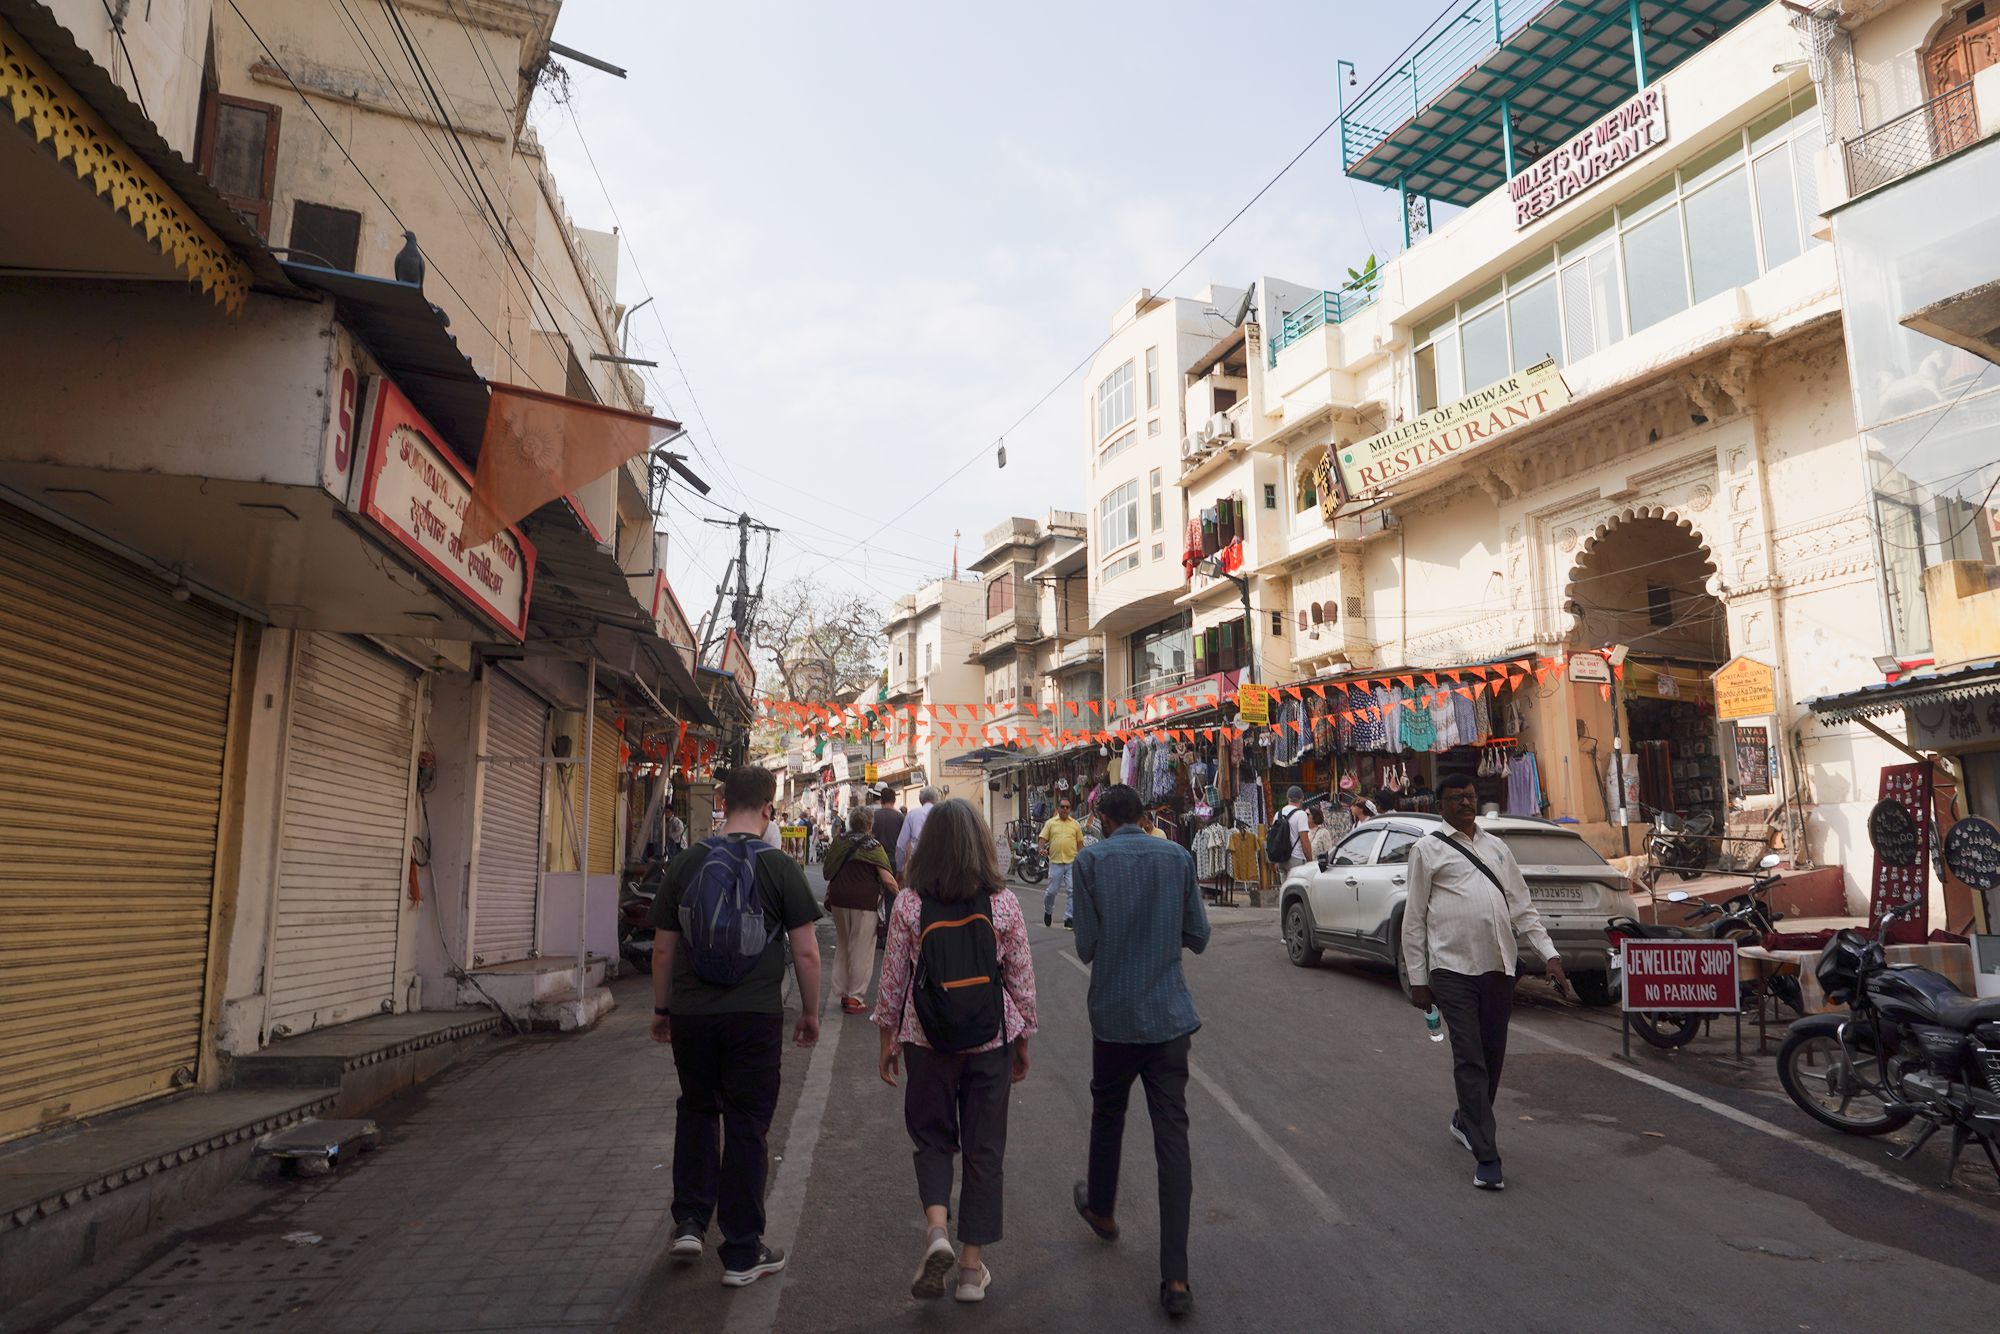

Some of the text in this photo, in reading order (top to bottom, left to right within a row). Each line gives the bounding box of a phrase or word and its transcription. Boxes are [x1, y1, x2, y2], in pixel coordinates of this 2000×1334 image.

[1509, 91, 1659, 201] MILLETS OF MEWAR
[1515, 120, 1653, 224] RESTAURANT
[1358, 389, 1549, 487] RESTAURANT
[1369, 378, 1520, 453] MILLETS OF MEWAR
[1628, 949, 1697, 975] JEWELLERY
[1701, 949, 1731, 975] SHOP
[1645, 983, 1718, 1001] NO PARKING
